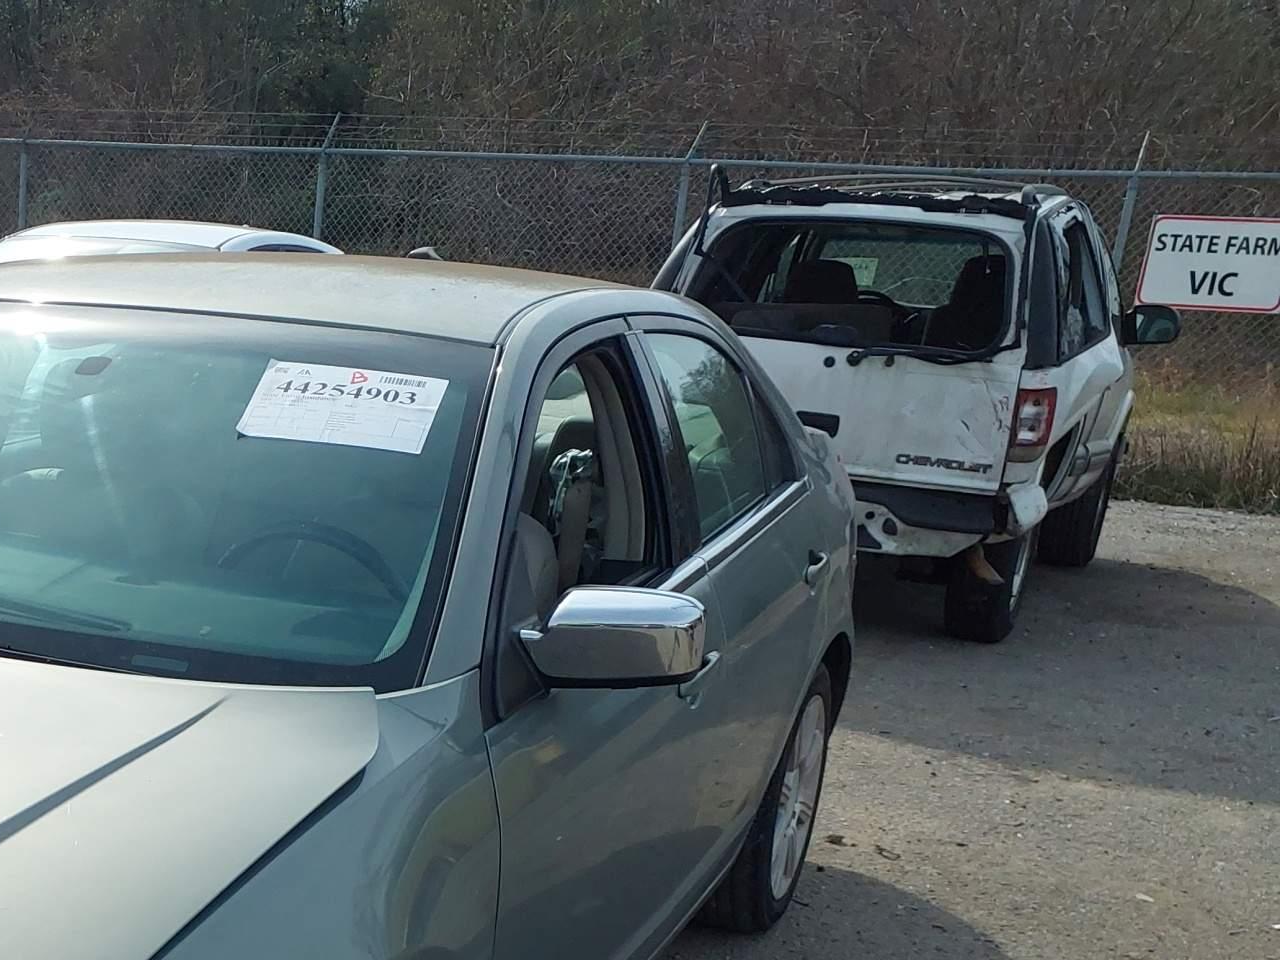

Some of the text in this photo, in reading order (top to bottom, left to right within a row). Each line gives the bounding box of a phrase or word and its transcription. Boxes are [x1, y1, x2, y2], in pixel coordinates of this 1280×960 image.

[1155, 233, 1280, 257] STATE FARM
[1190, 270, 1239, 297] VIC
[276, 380, 417, 405] 44254903
[895, 453, 993, 474] CHEVROLET
